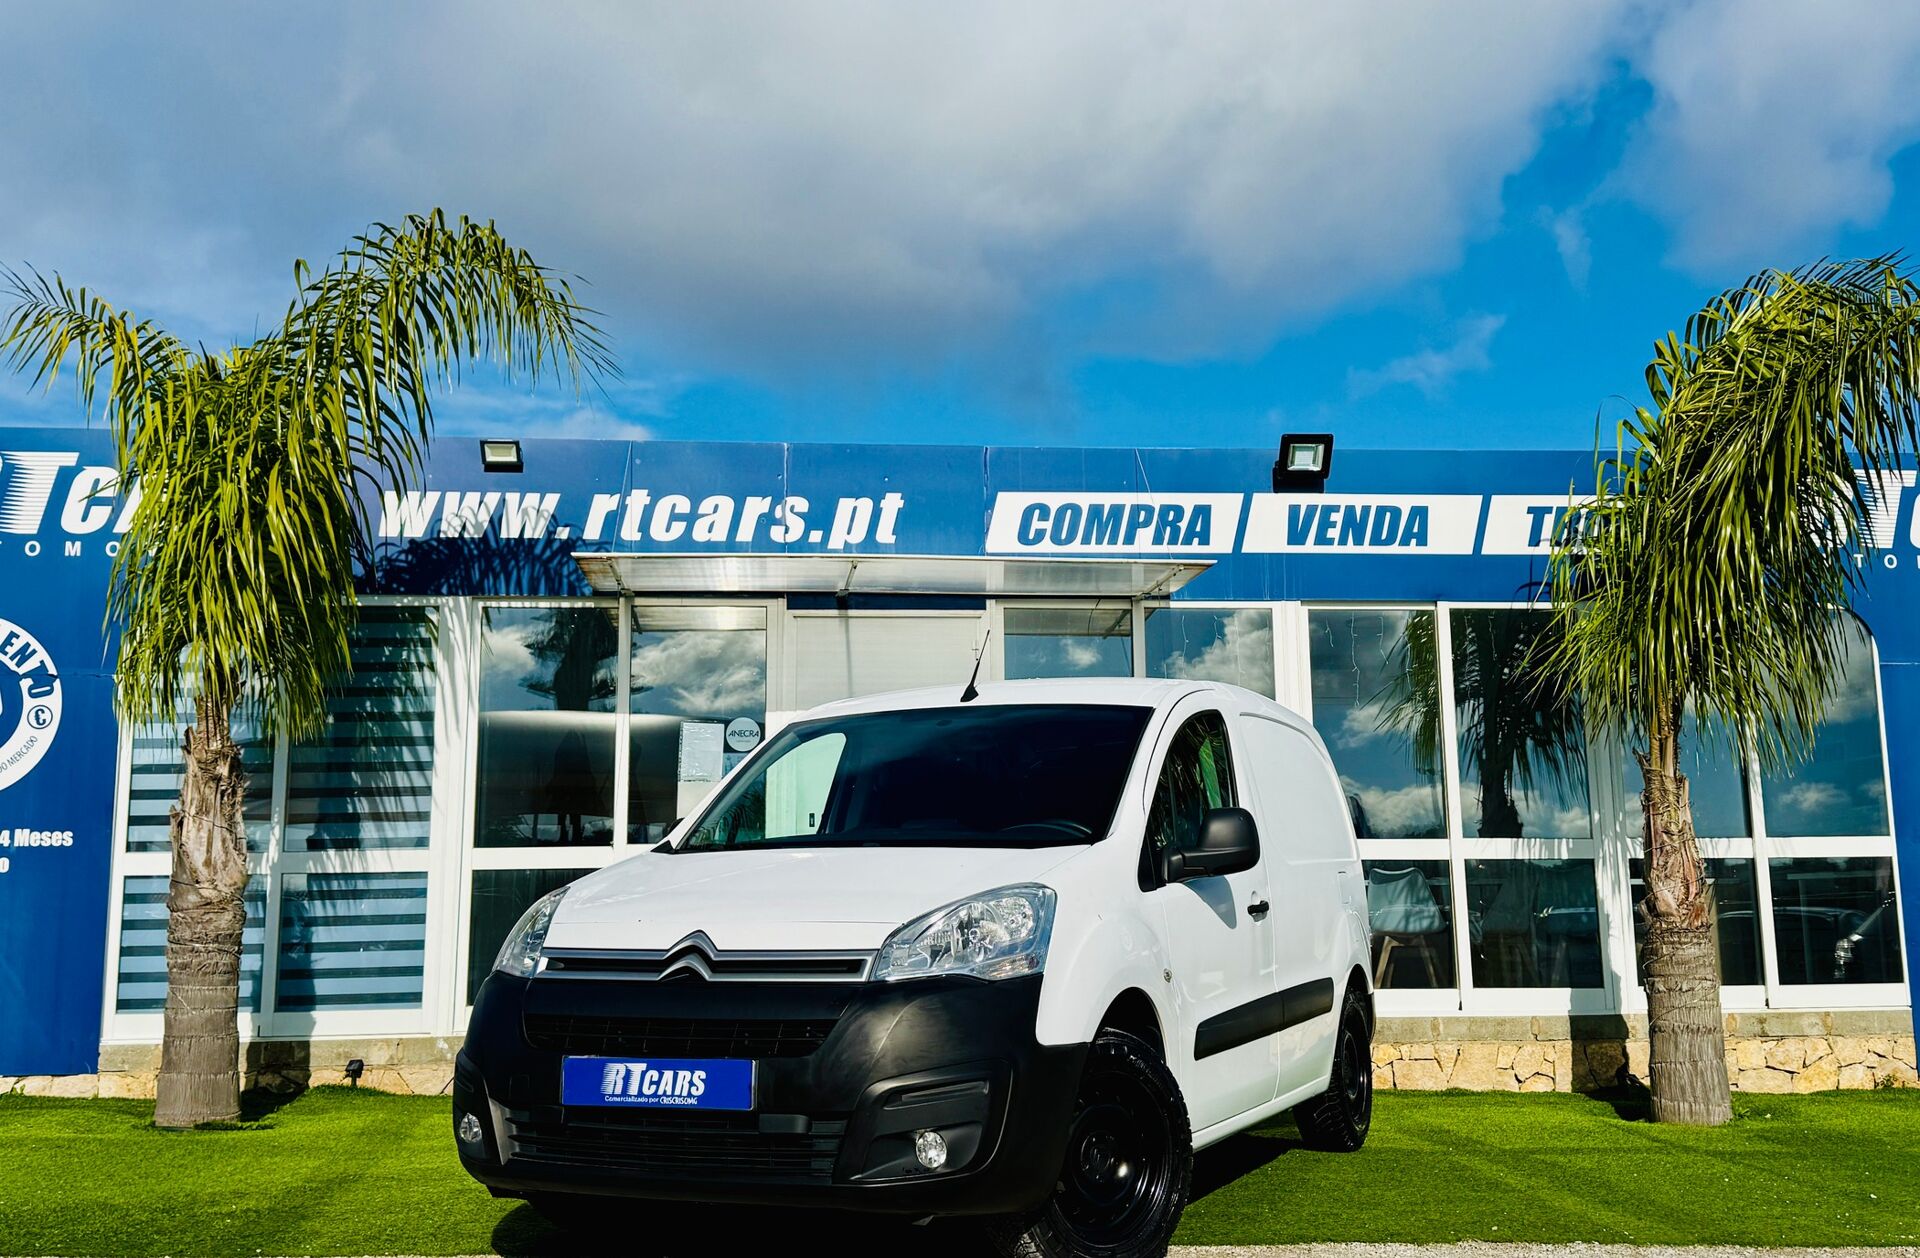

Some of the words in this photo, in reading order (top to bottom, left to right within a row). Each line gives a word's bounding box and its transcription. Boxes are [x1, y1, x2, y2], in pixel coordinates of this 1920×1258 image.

[1017, 502, 1211, 546] COMPRA
[1287, 504, 1428, 547] VENDA
[728, 729, 760, 738] ANECRA
[7, 735, 38, 767] MERCADO
[14, 828, 73, 847] Meses
[604, 1095, 649, 1103] Comercializado
